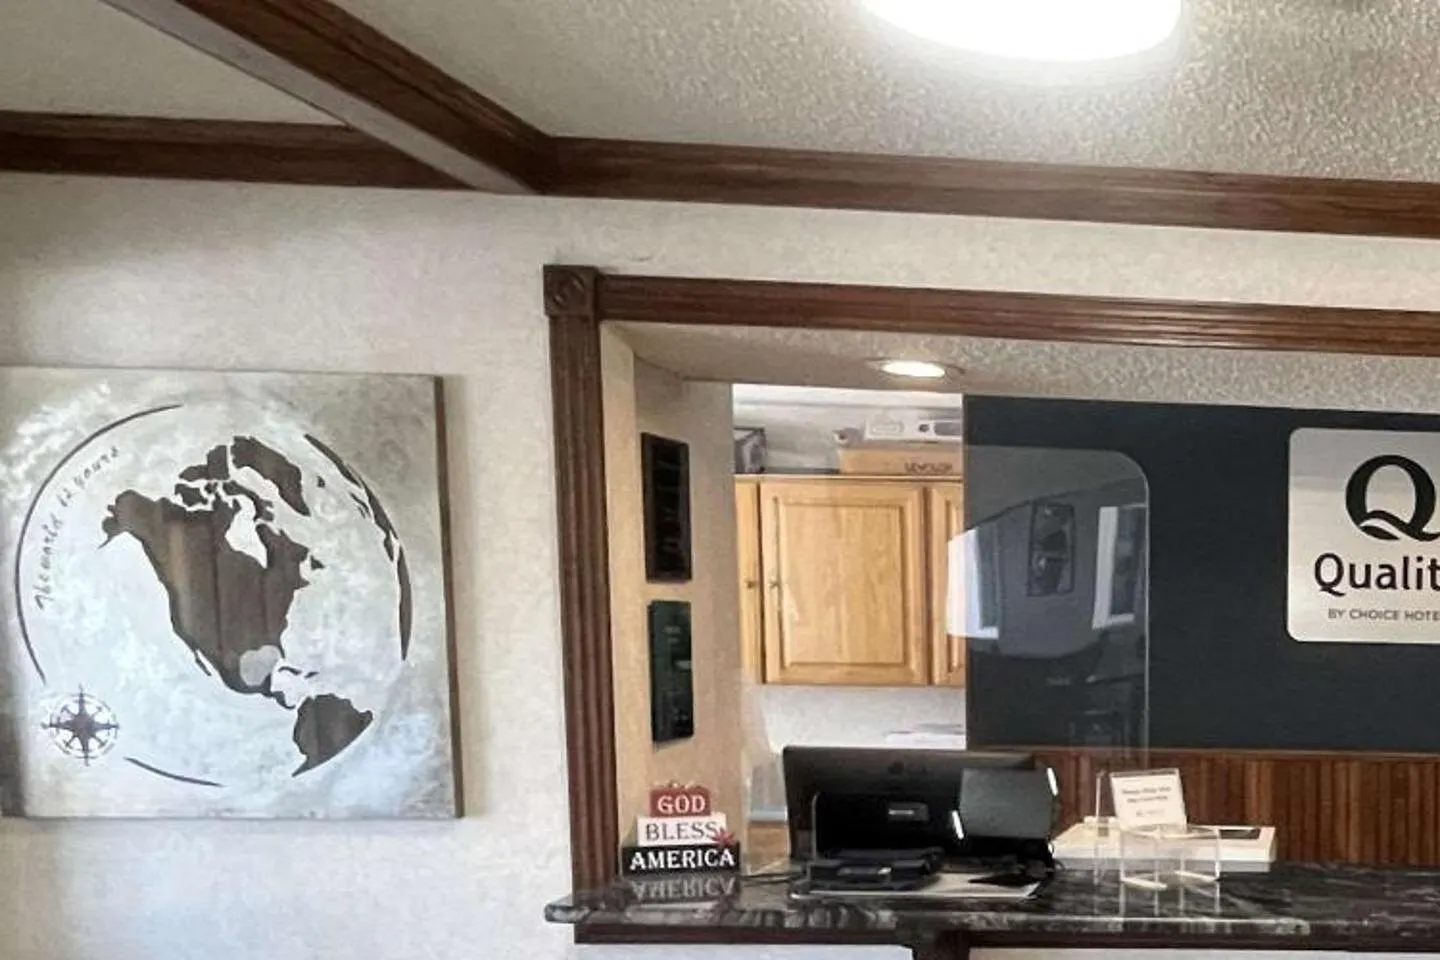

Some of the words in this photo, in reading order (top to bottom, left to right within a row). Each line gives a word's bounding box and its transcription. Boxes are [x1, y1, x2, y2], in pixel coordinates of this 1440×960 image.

[1328, 608, 1345, 620] BY
[1349, 608, 1400, 621] CHOICE
[657, 794, 707, 815] GOD
[645, 821, 718, 842] BLESS
[628, 847, 736, 871] AMERICA
